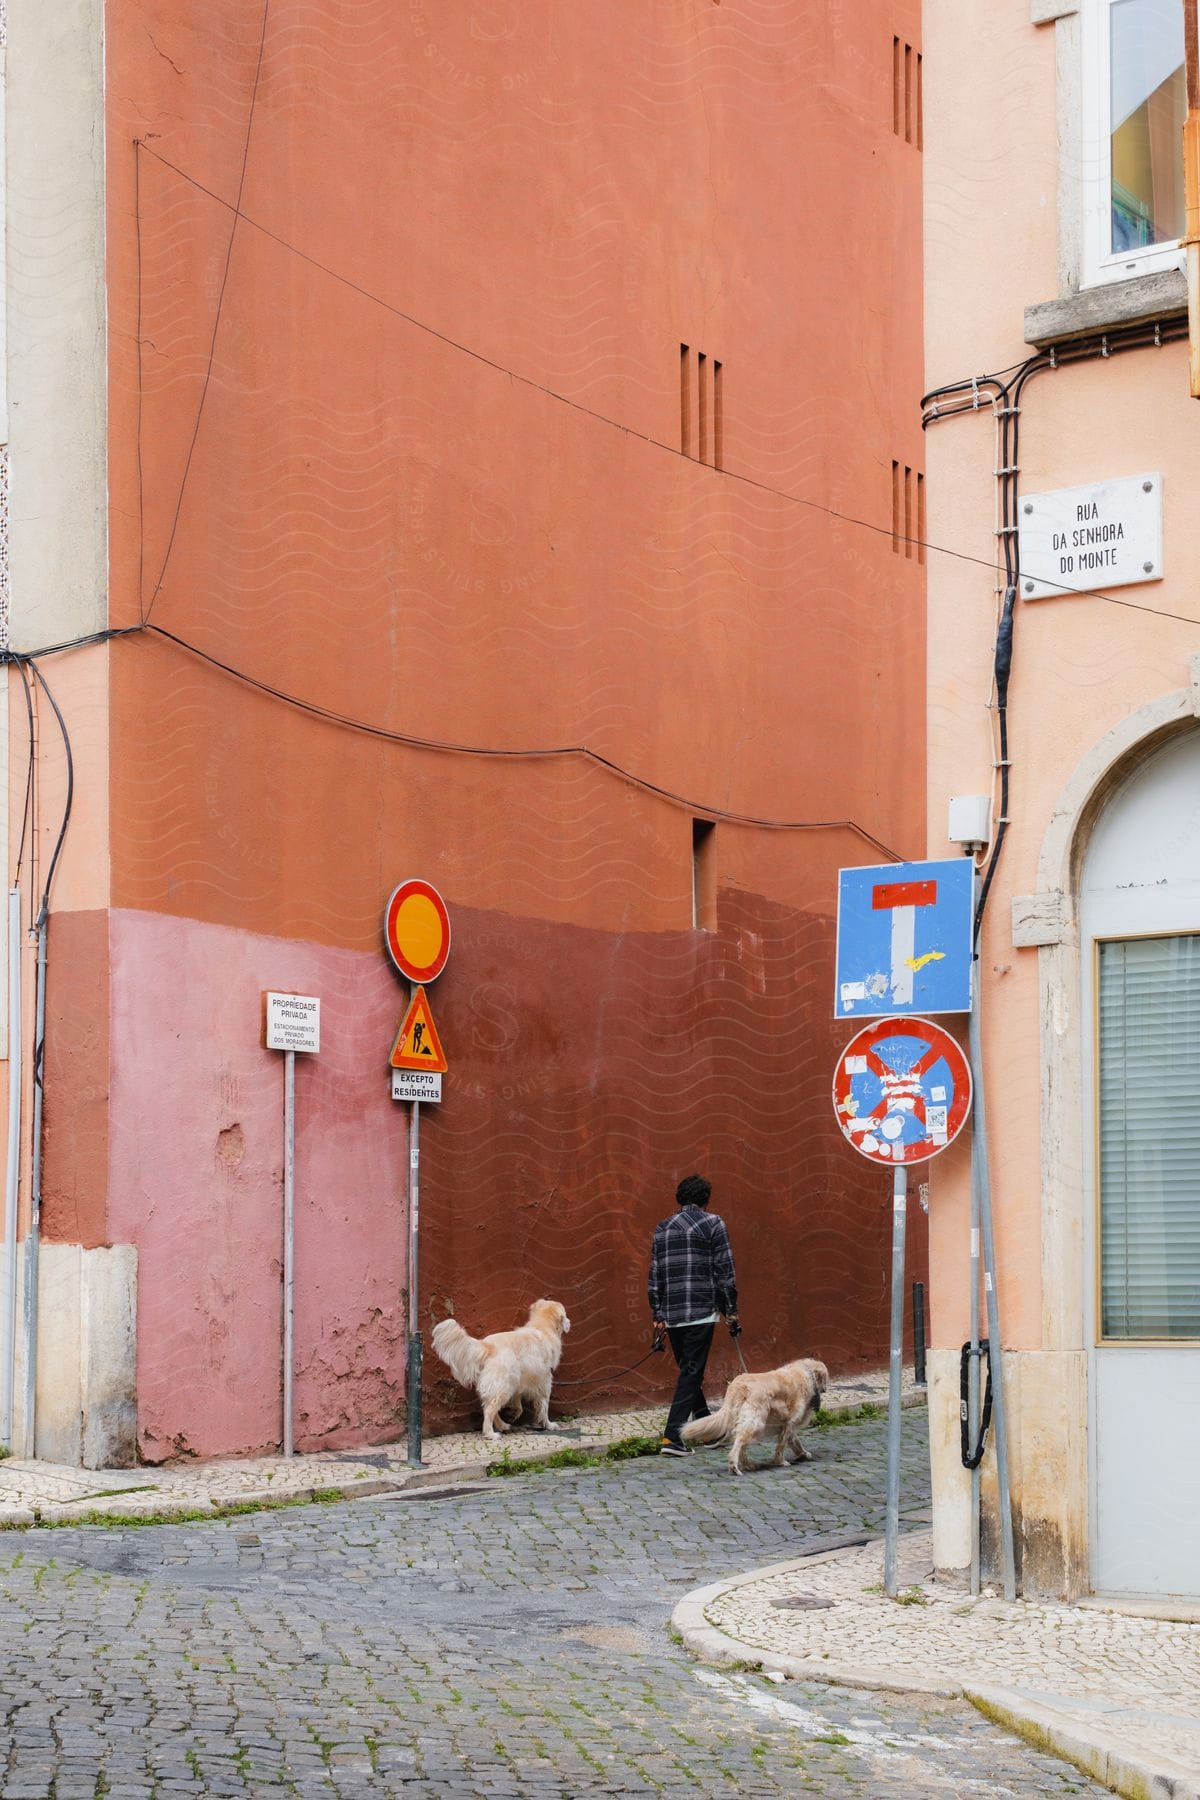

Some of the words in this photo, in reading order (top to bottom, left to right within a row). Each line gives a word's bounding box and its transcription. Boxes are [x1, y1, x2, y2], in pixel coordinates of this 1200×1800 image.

[1076, 502, 1099, 522] RUA
[1052, 532, 1067, 551] DA
[1072, 522, 1125, 547] SENHORA
[1060, 555, 1074, 574] DO
[1078, 548, 1118, 571] MONTE
[272, 999, 317, 1012] PROPRIEDADE
[281, 1009, 308, 1020] PRIVADA
[400, 1073, 434, 1084] EXCEPTO
[394, 1087, 440, 1098] RESIDENTES
